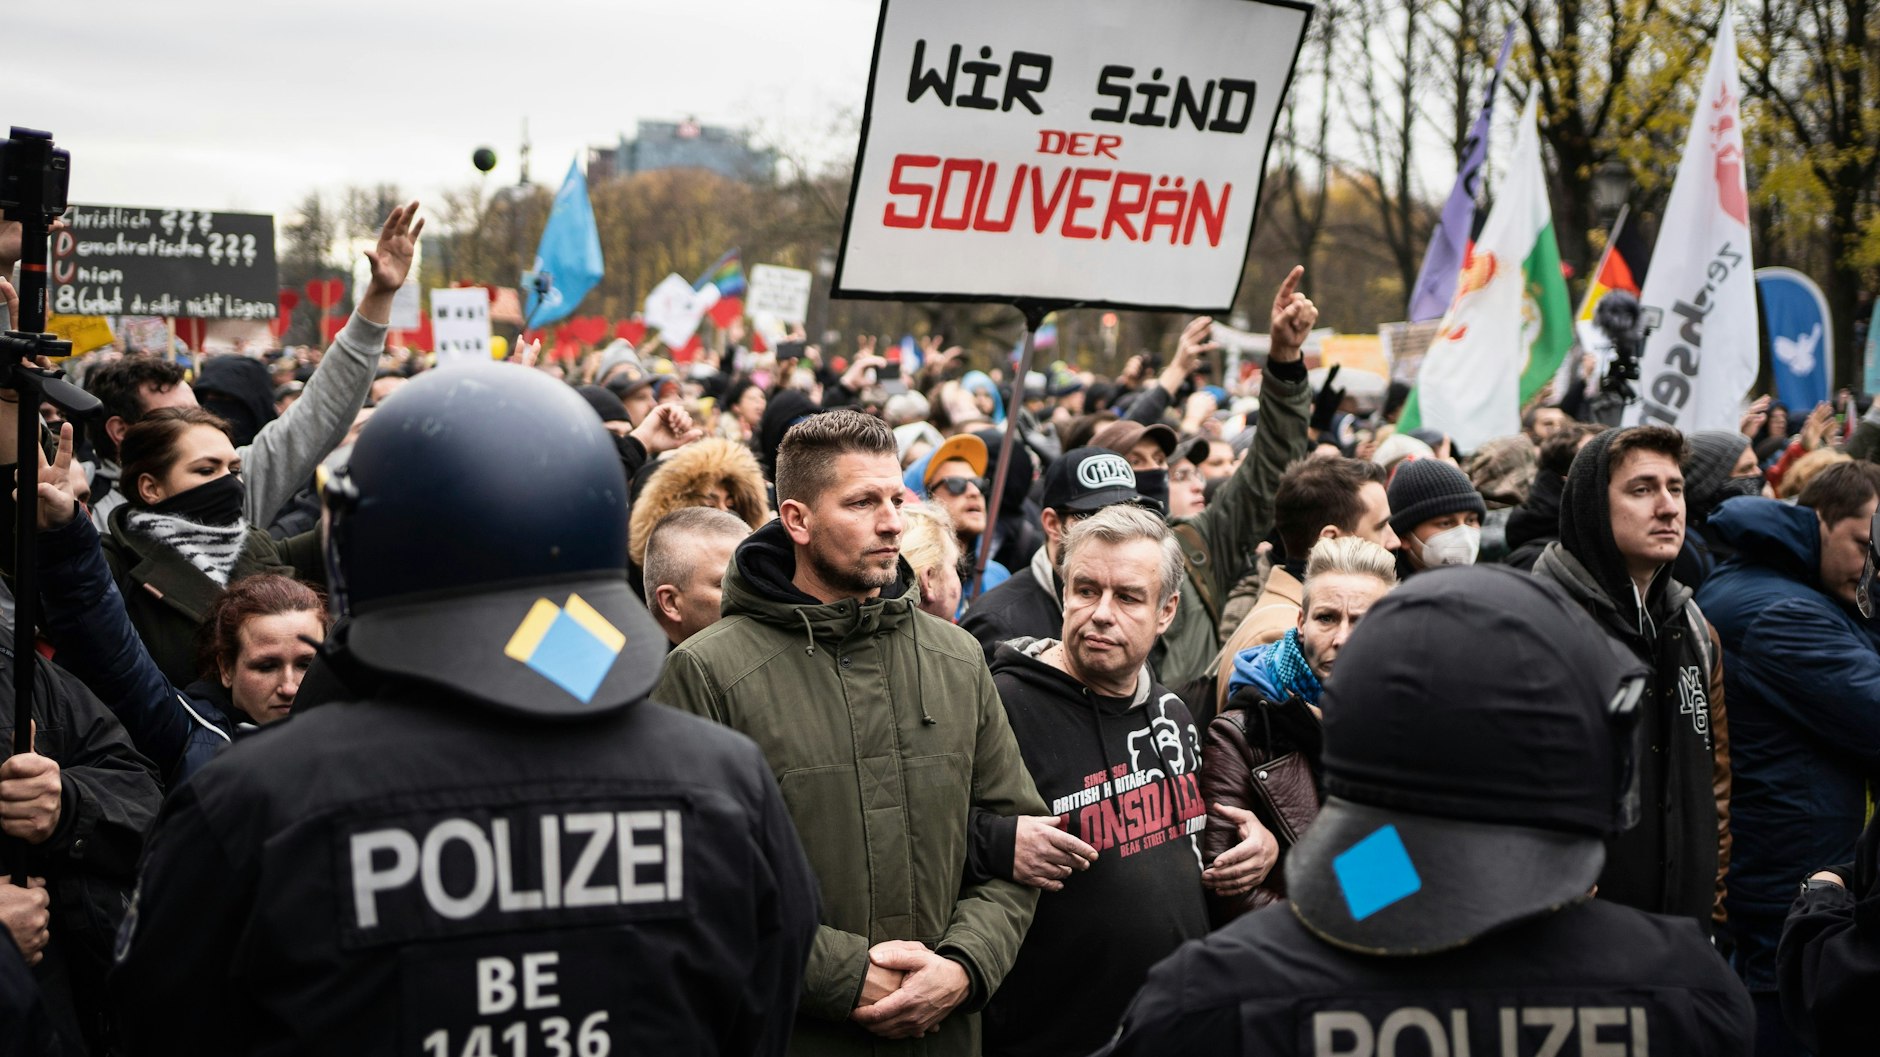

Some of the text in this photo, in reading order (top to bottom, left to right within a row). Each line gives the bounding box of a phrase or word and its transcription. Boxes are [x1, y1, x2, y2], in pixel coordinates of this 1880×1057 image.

[1036, 130, 1123, 160] DER
[883, 154, 1232, 248] SOUVERÄN
[55, 260, 123, 284] Union
[1053, 769, 1147, 816] BRITISH HRITAGE
[1083, 762, 1128, 788] SINCE 960
[1143, 830, 1166, 850] STREET
[349, 810, 684, 928] POLIZEI
[477, 951, 560, 1015] BE
